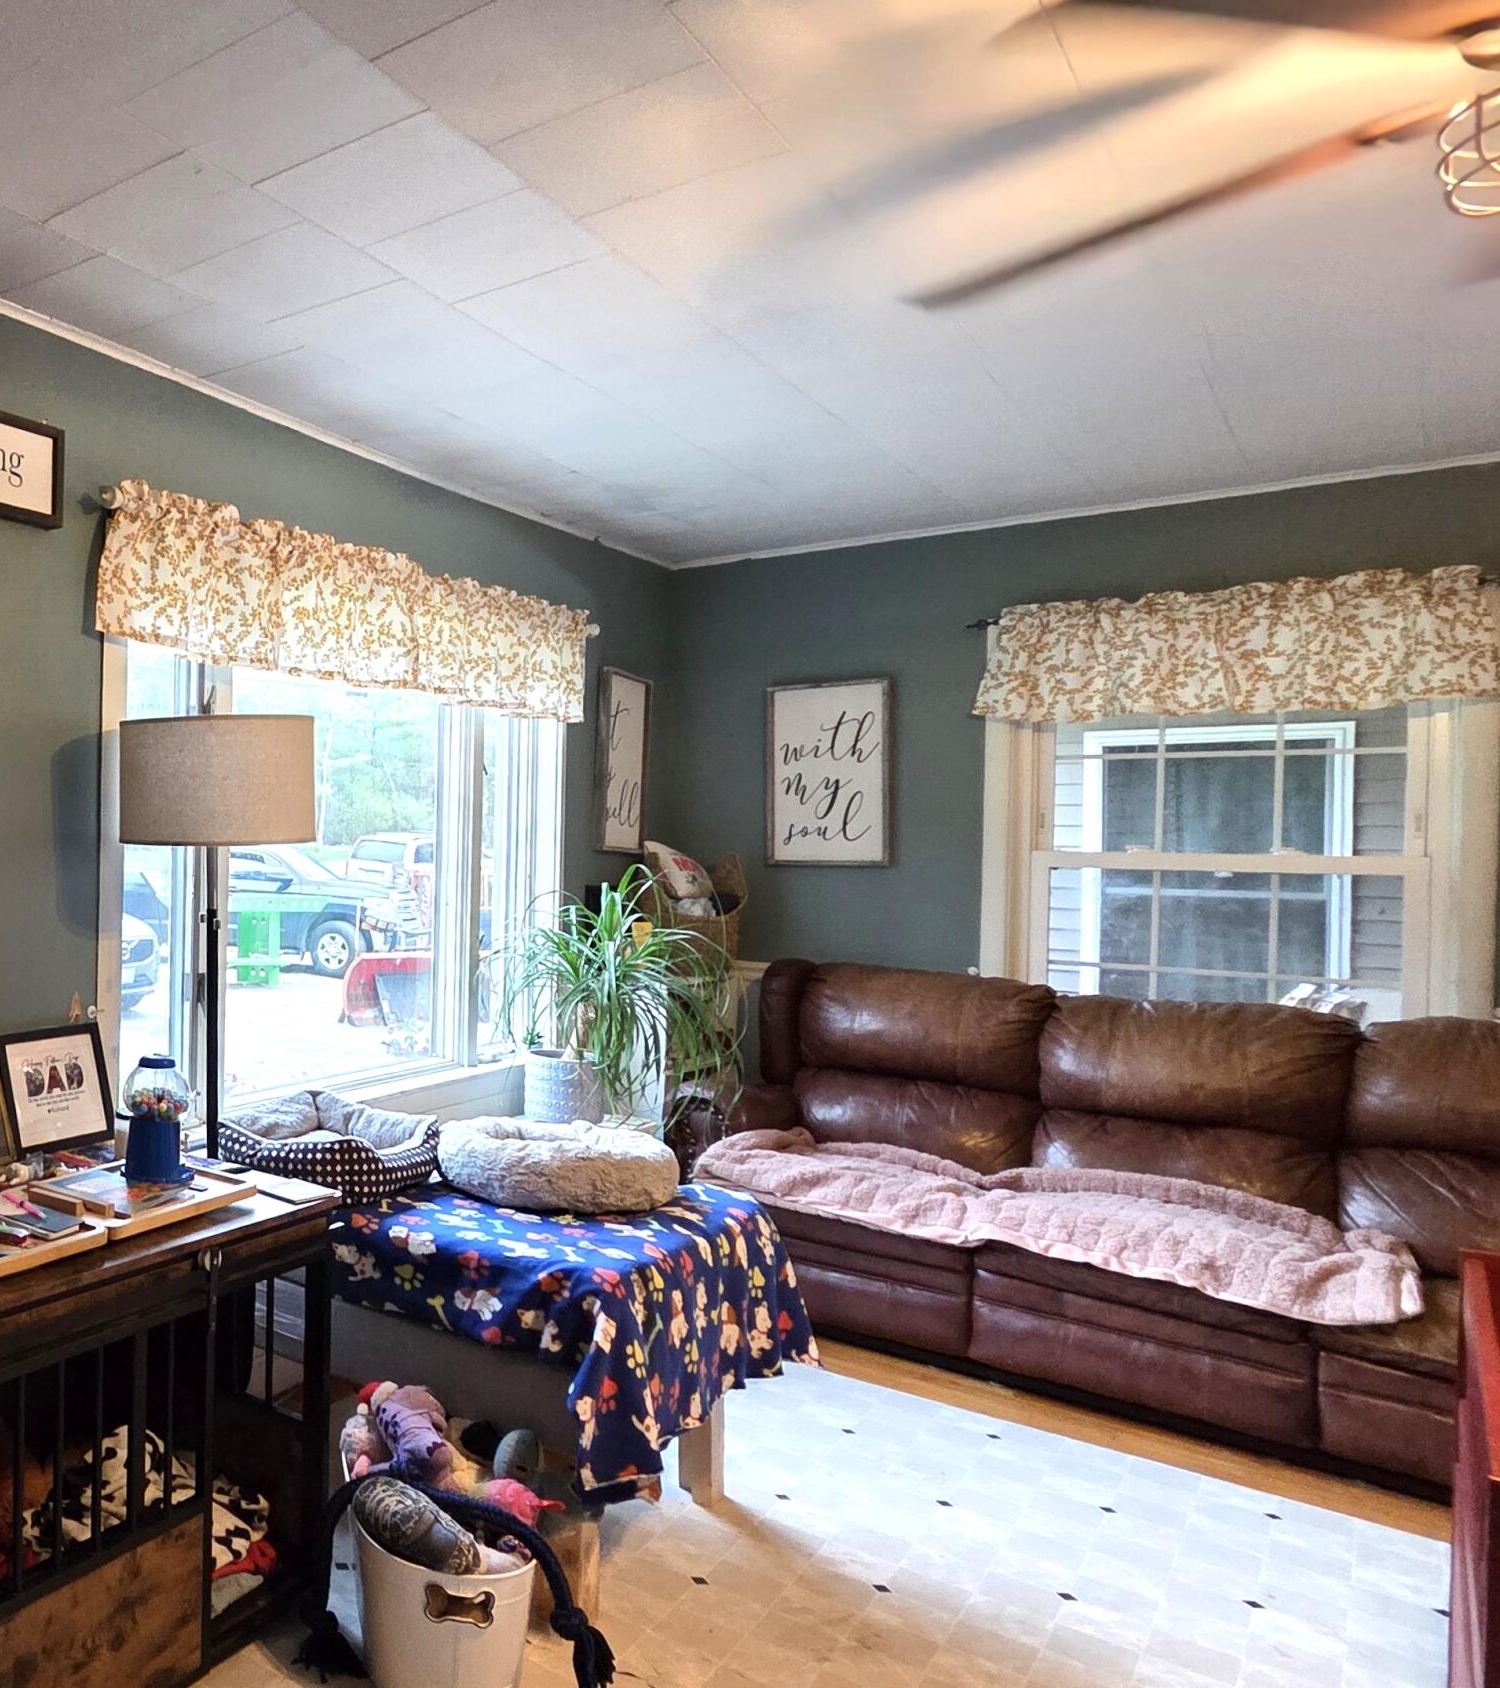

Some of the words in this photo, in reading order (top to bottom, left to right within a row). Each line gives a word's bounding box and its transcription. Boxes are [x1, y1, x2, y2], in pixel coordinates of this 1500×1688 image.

[780, 710, 880, 766] with
[781, 772, 853, 820] my
[783, 791, 872, 846] soul
[23, 1062, 84, 1098] DAD
